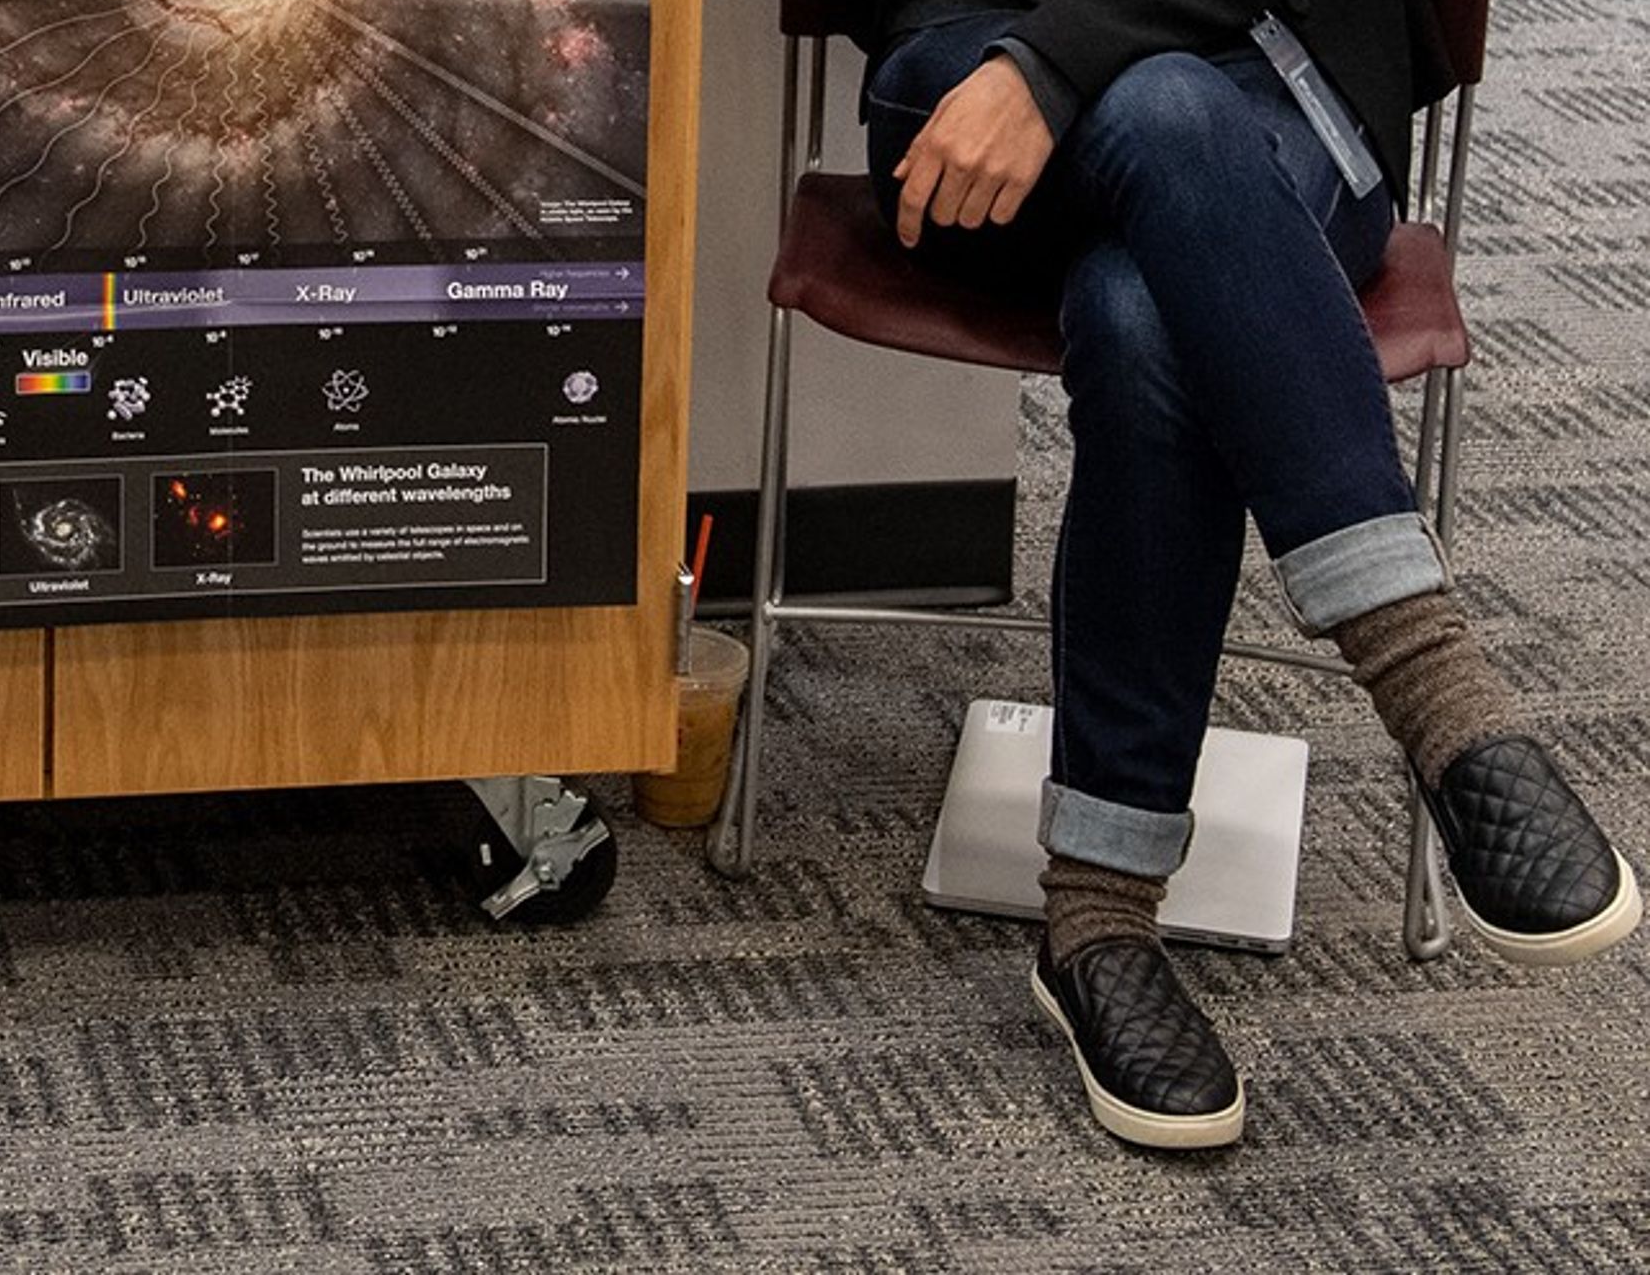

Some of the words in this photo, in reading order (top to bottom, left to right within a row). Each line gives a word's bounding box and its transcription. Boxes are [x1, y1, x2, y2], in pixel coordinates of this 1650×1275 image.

[123, 287, 226, 306] Ultraviolet
[296, 285, 357, 305] X-Ray
[447, 282, 525, 300] Gamma
[530, 280, 570, 301] Ray
[22, 348, 90, 369] Visible
[303, 467, 334, 481] The
[339, 465, 422, 484] Whirlpool
[427, 464, 486, 482] Galaxy
[301, 490, 318, 504] at
[324, 488, 396, 503] different
[402, 485, 510, 504] wavelengths
[29, 578, 91, 595] Ultraviolet
[194, 570, 233, 588] X-Ray
